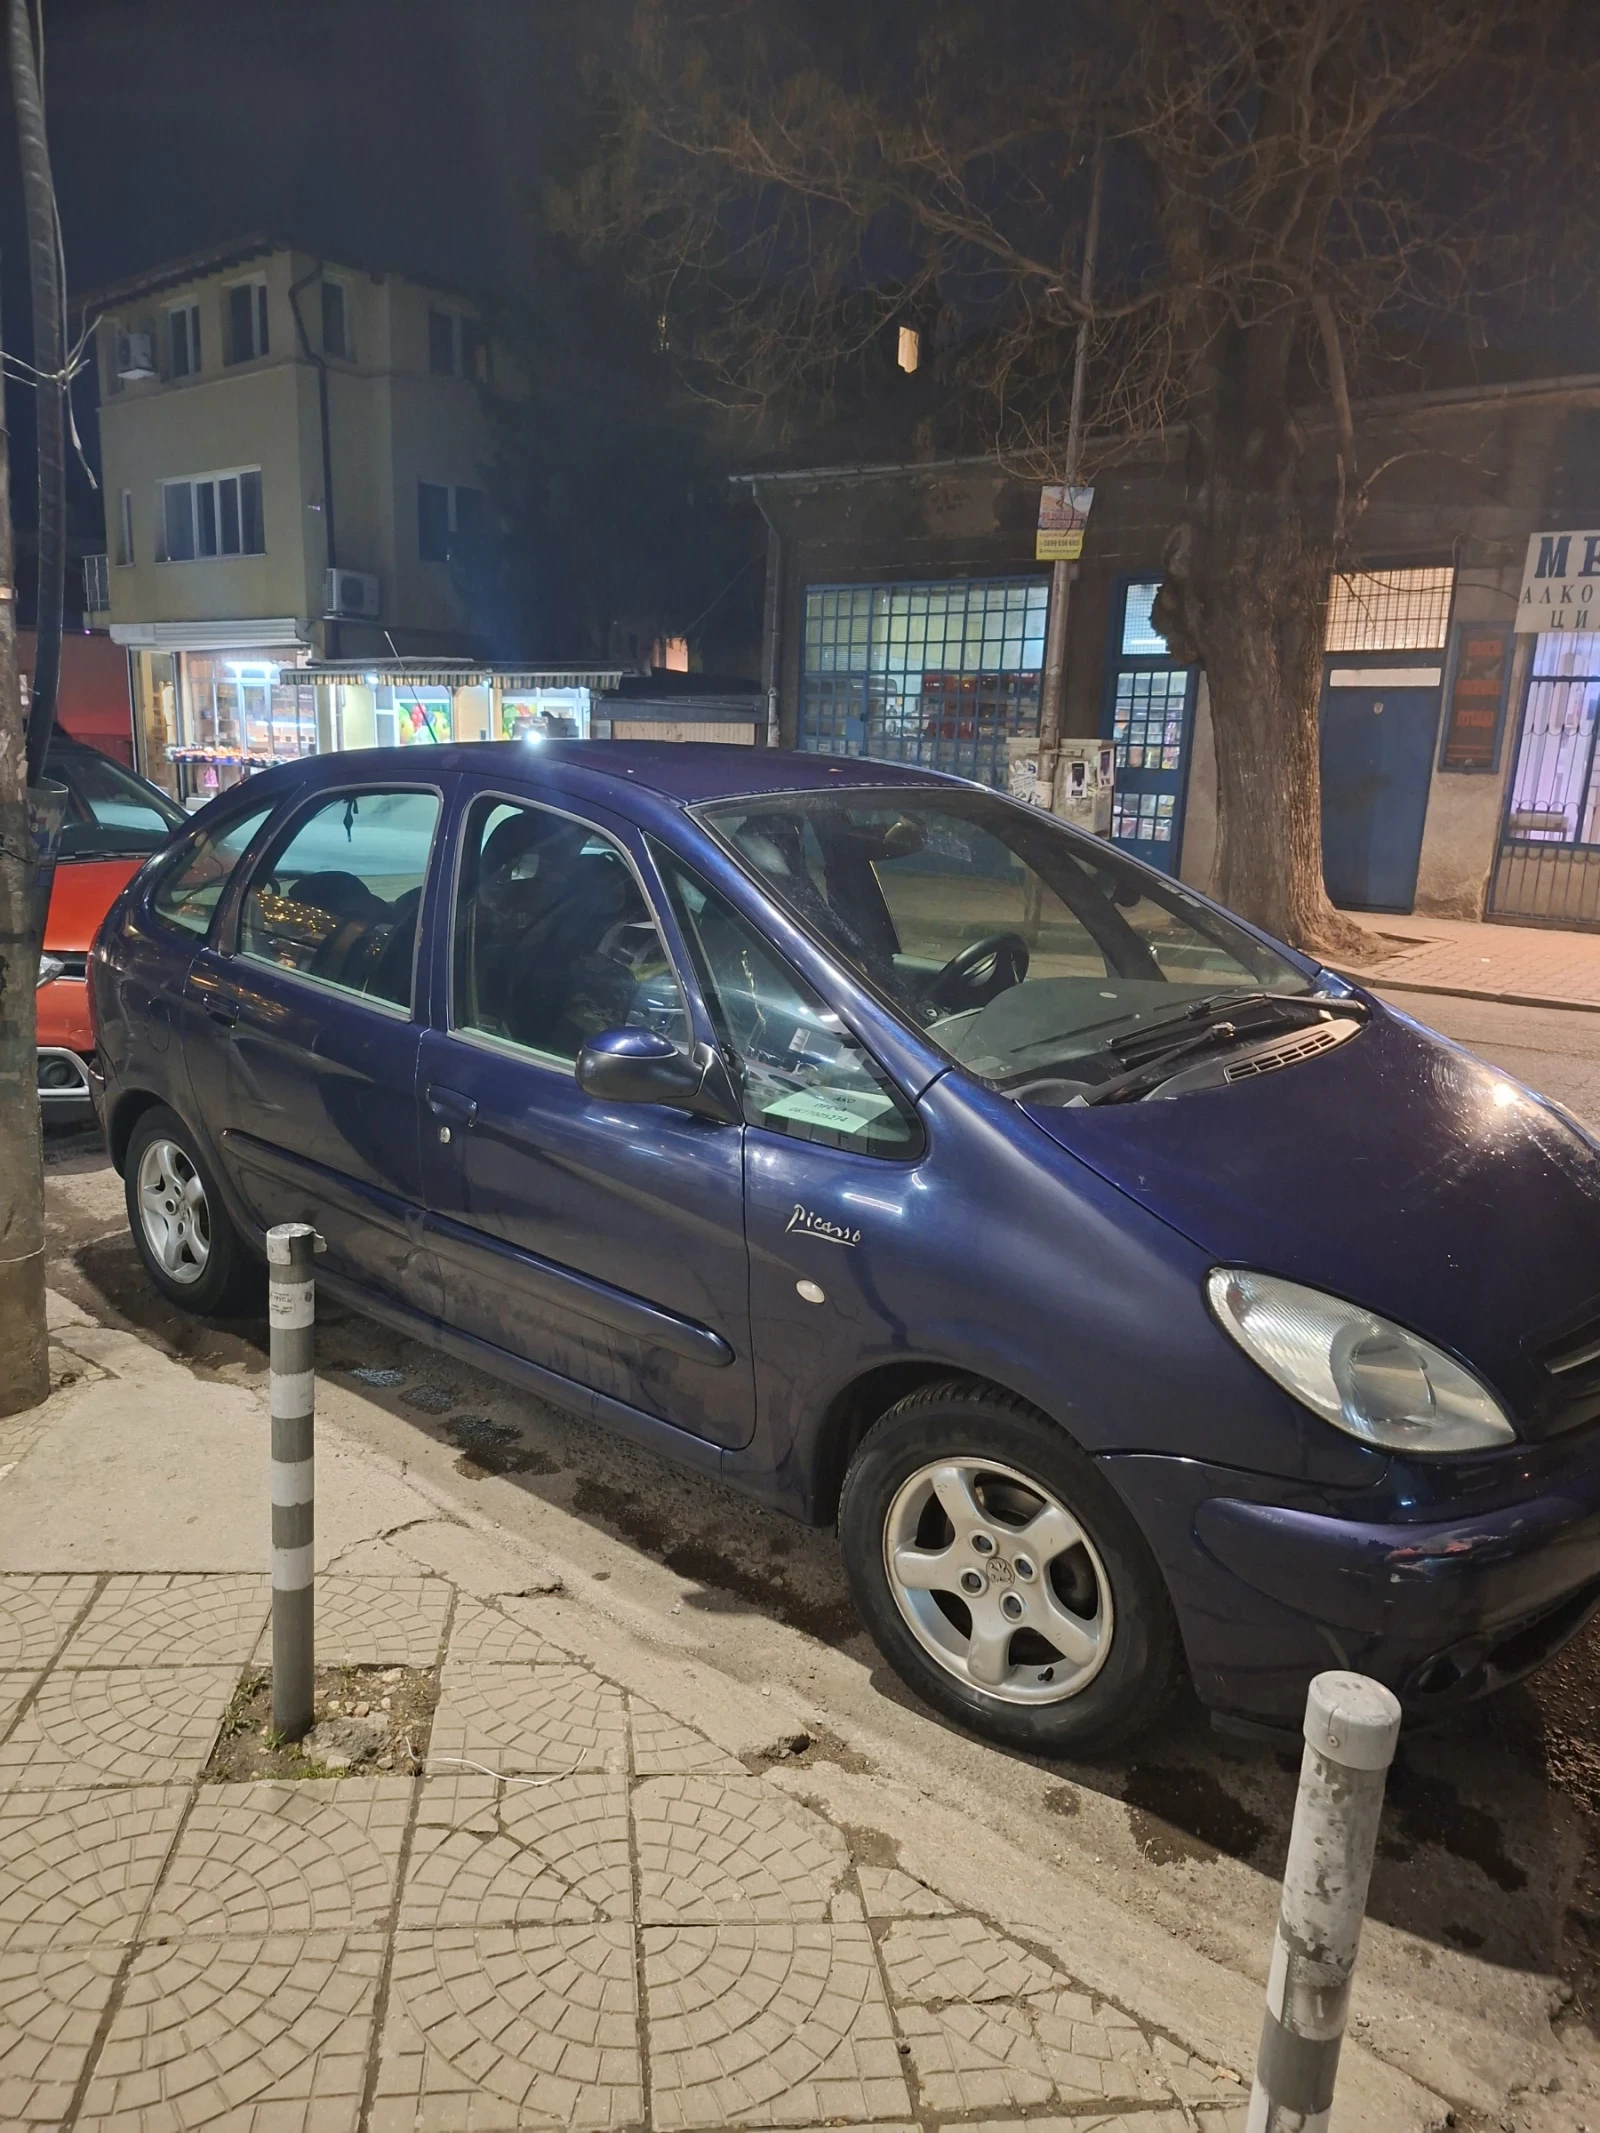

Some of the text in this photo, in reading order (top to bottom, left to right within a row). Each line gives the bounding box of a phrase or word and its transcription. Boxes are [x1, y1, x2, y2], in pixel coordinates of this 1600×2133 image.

[1521, 584, 1594, 604] АЛКО
[1550, 609, 1600, 629] ЦИ
[784, 1203, 862, 1245] Picasso
